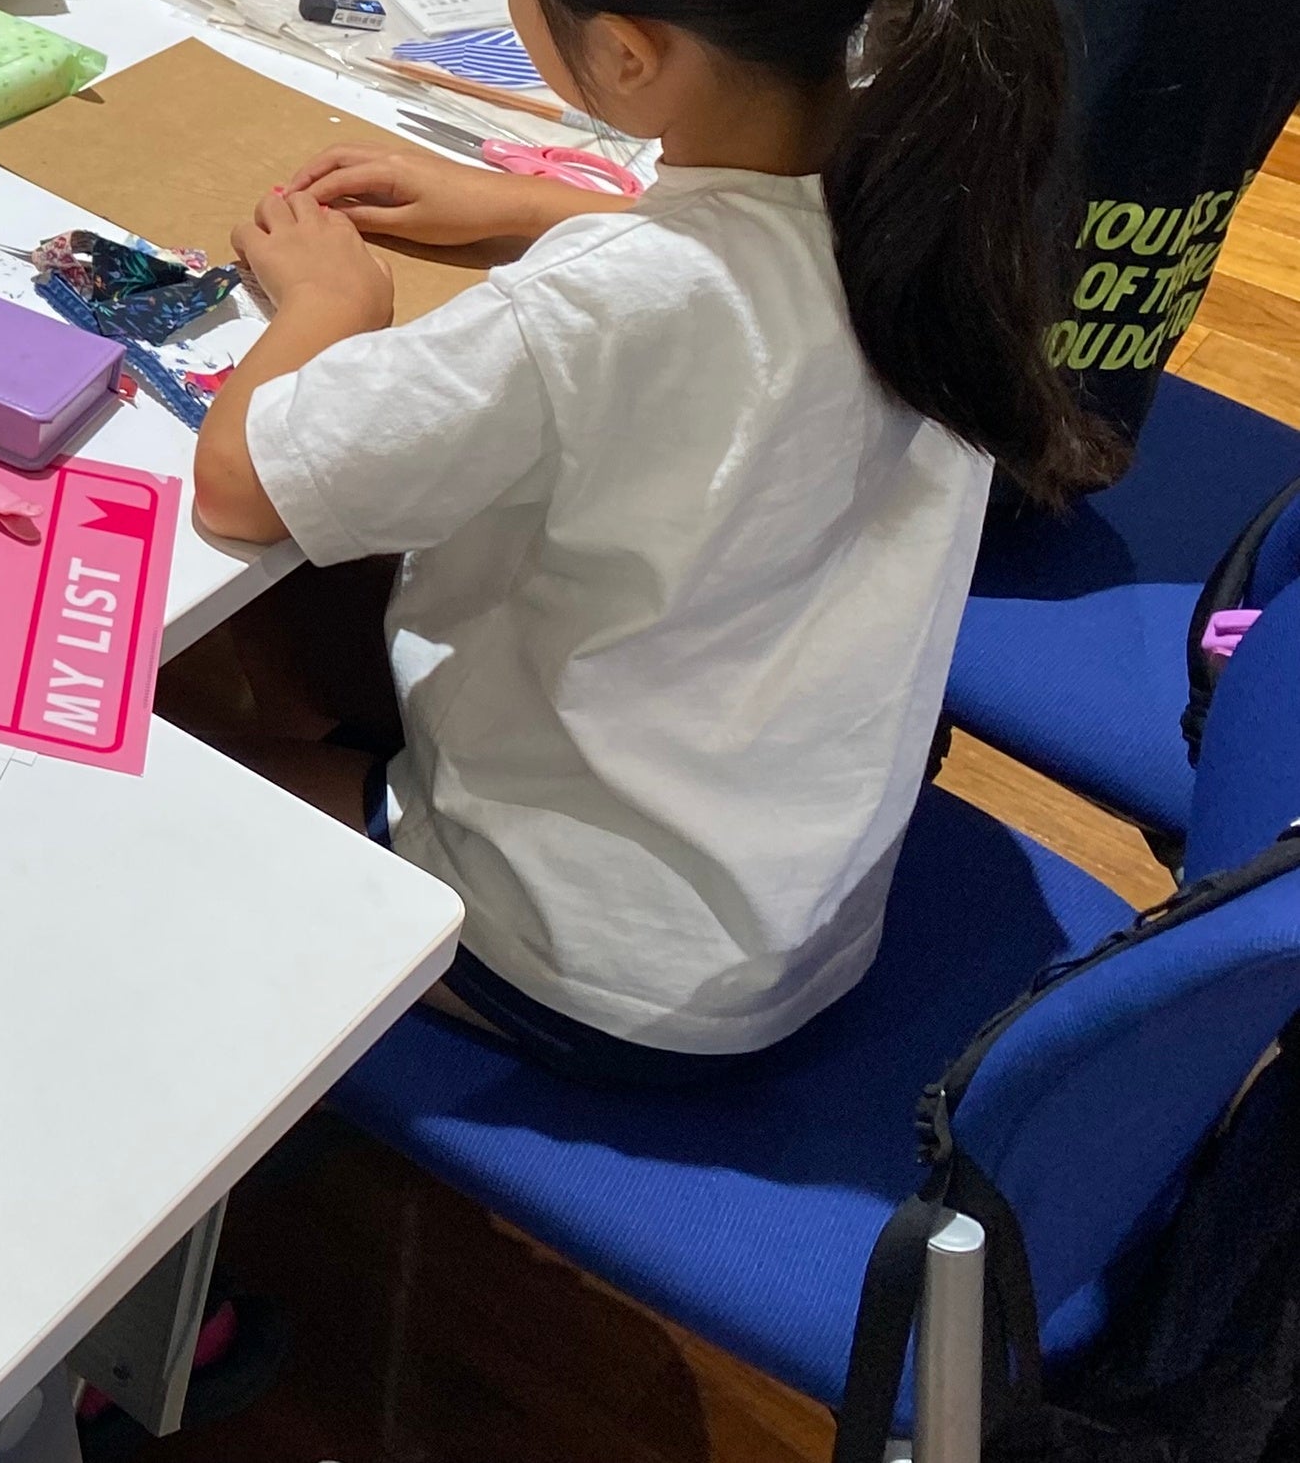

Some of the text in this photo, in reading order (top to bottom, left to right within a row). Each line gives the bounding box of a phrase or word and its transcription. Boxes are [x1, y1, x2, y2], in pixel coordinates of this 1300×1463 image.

[1075, 200, 1183, 256] YOU
[1073, 262, 1149, 312] OF
[43, 557, 121, 735] MY LIST
